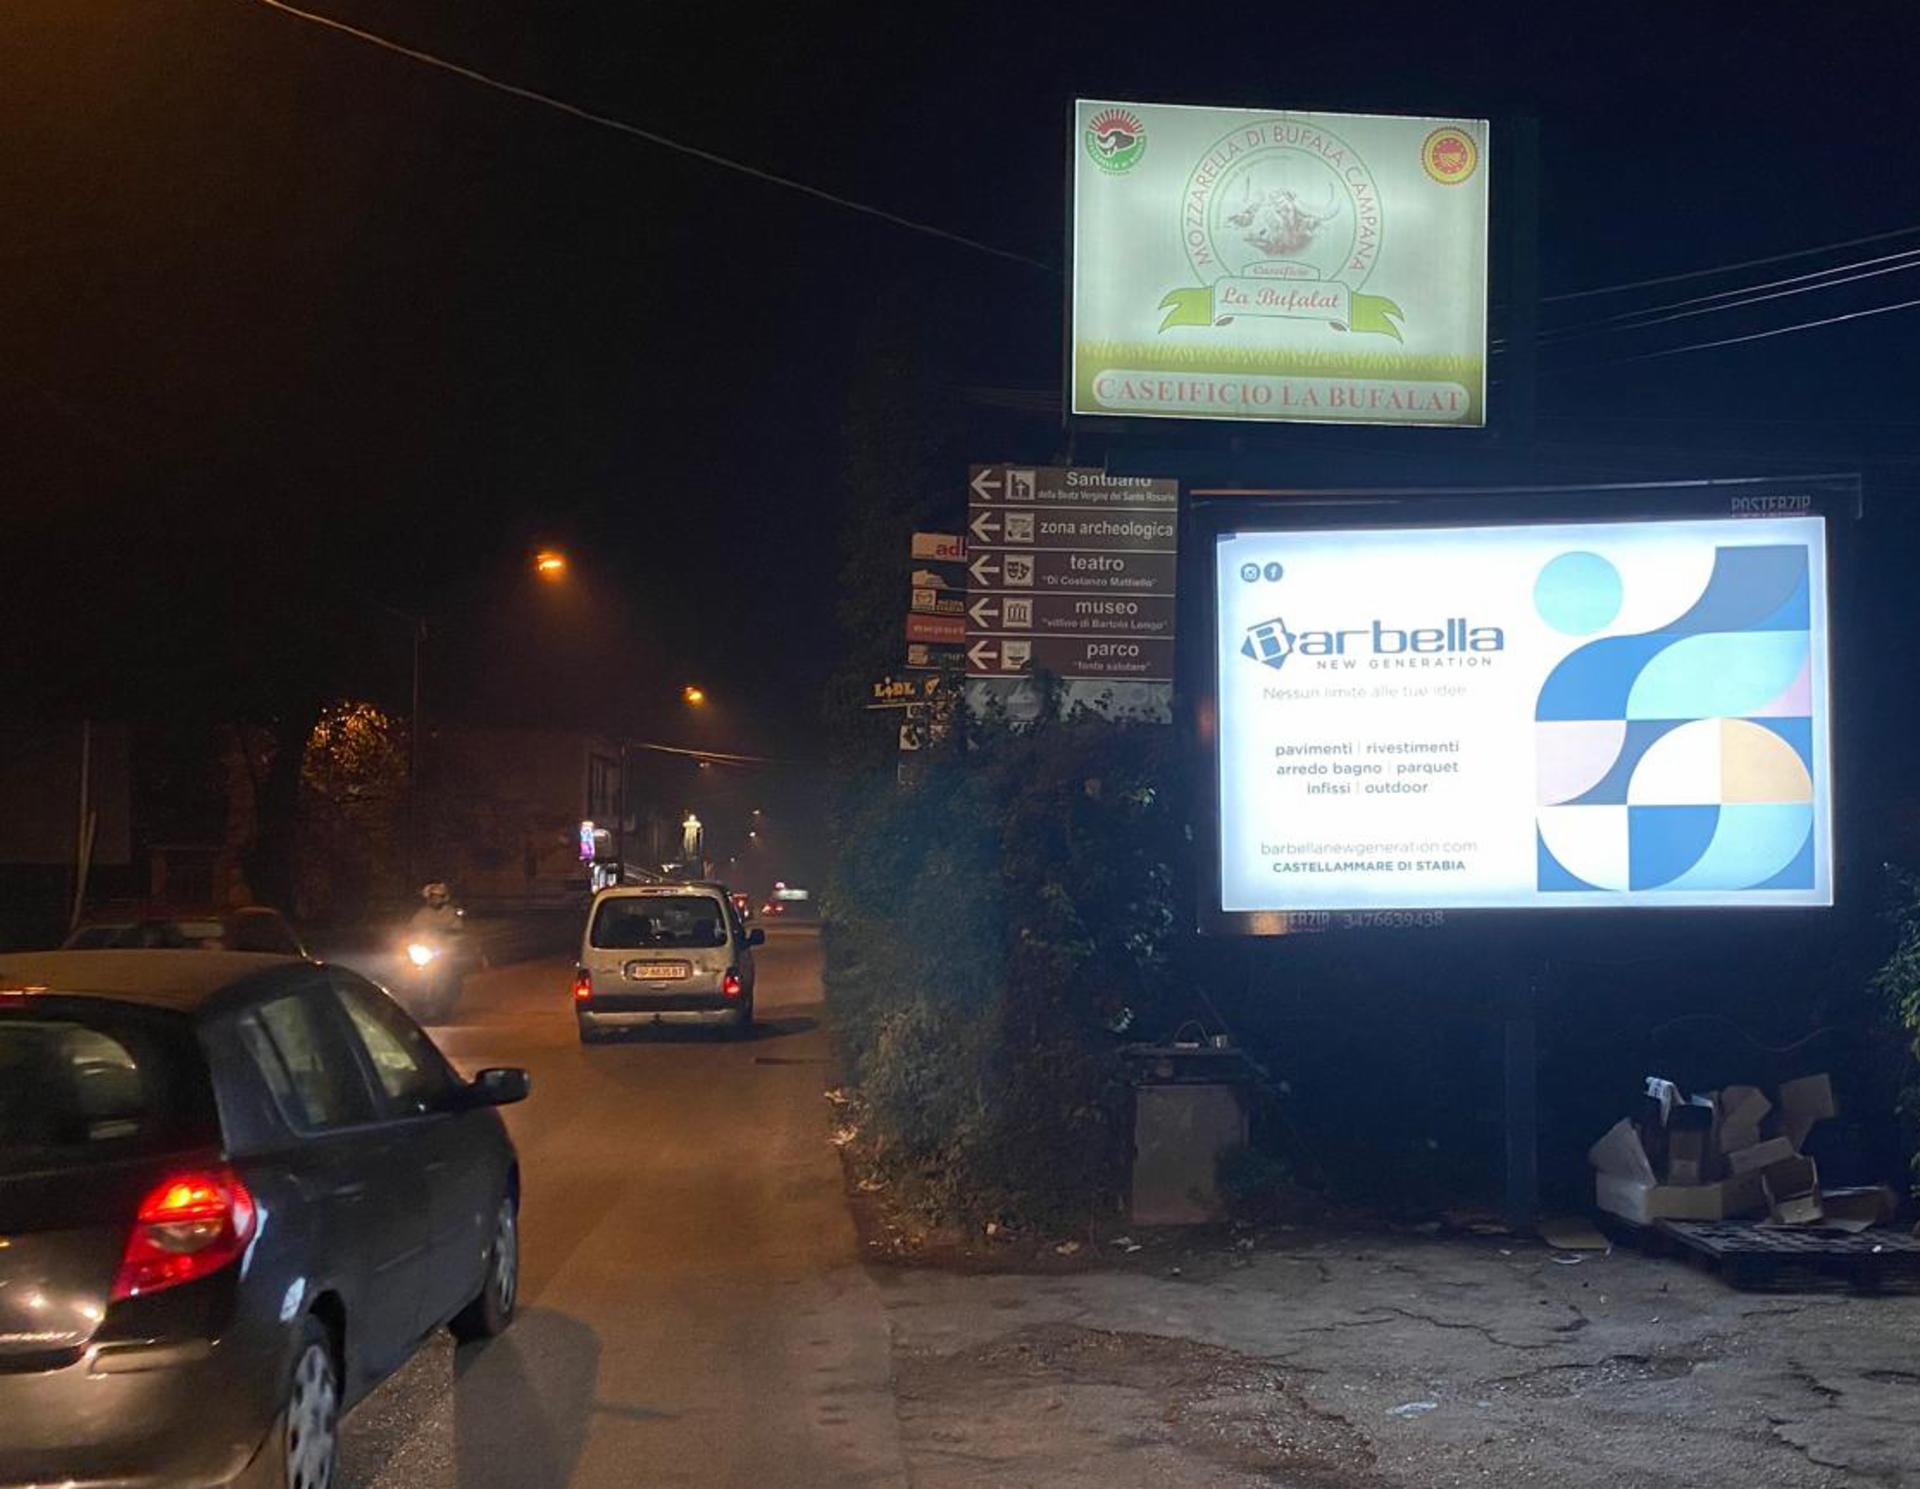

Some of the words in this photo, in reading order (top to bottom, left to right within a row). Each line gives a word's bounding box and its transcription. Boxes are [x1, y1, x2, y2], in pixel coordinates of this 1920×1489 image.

[1187, 142, 1240, 266] MOZZARELLA
[1246, 128, 1266, 147] DI
[1274, 125, 1346, 167] BUFALA
[1345, 166, 1378, 270] CAMPANA
[1221, 287, 1248, 304] La
[1256, 287, 1339, 311] Bufalat
[1099, 378, 1272, 405] CASEIFICIO
[1282, 385, 1317, 407] LA
[1329, 386, 1462, 412] BUFALAT
[1040, 521, 1075, 534] zona
[1079, 520, 1174, 540] archeologica
[1070, 554, 1125, 571] teatro
[1075, 601, 1139, 614] museo
[1087, 643, 1139, 659] parco
[1317, 659, 1356, 670] NEW
[1369, 657, 1492, 669] GENERATION
[1263, 687, 1319, 700] Nessun
[1275, 742, 1353, 757] pavimenti
[1366, 740, 1459, 755] rivestimenti
[1276, 762, 1328, 775] arredo
[1333, 762, 1382, 776] bagno
[1397, 761, 1459, 776] parquet
[1307, 781, 1351, 794] infissi
[1365, 780, 1428, 794] outdoor
[1261, 839, 1478, 857] barbellanewgenerationcom
[1272, 861, 1394, 873] CASTELLAMMARE
[1397, 860, 1412, 872] DI
[1416, 860, 1466, 872] STABIA
